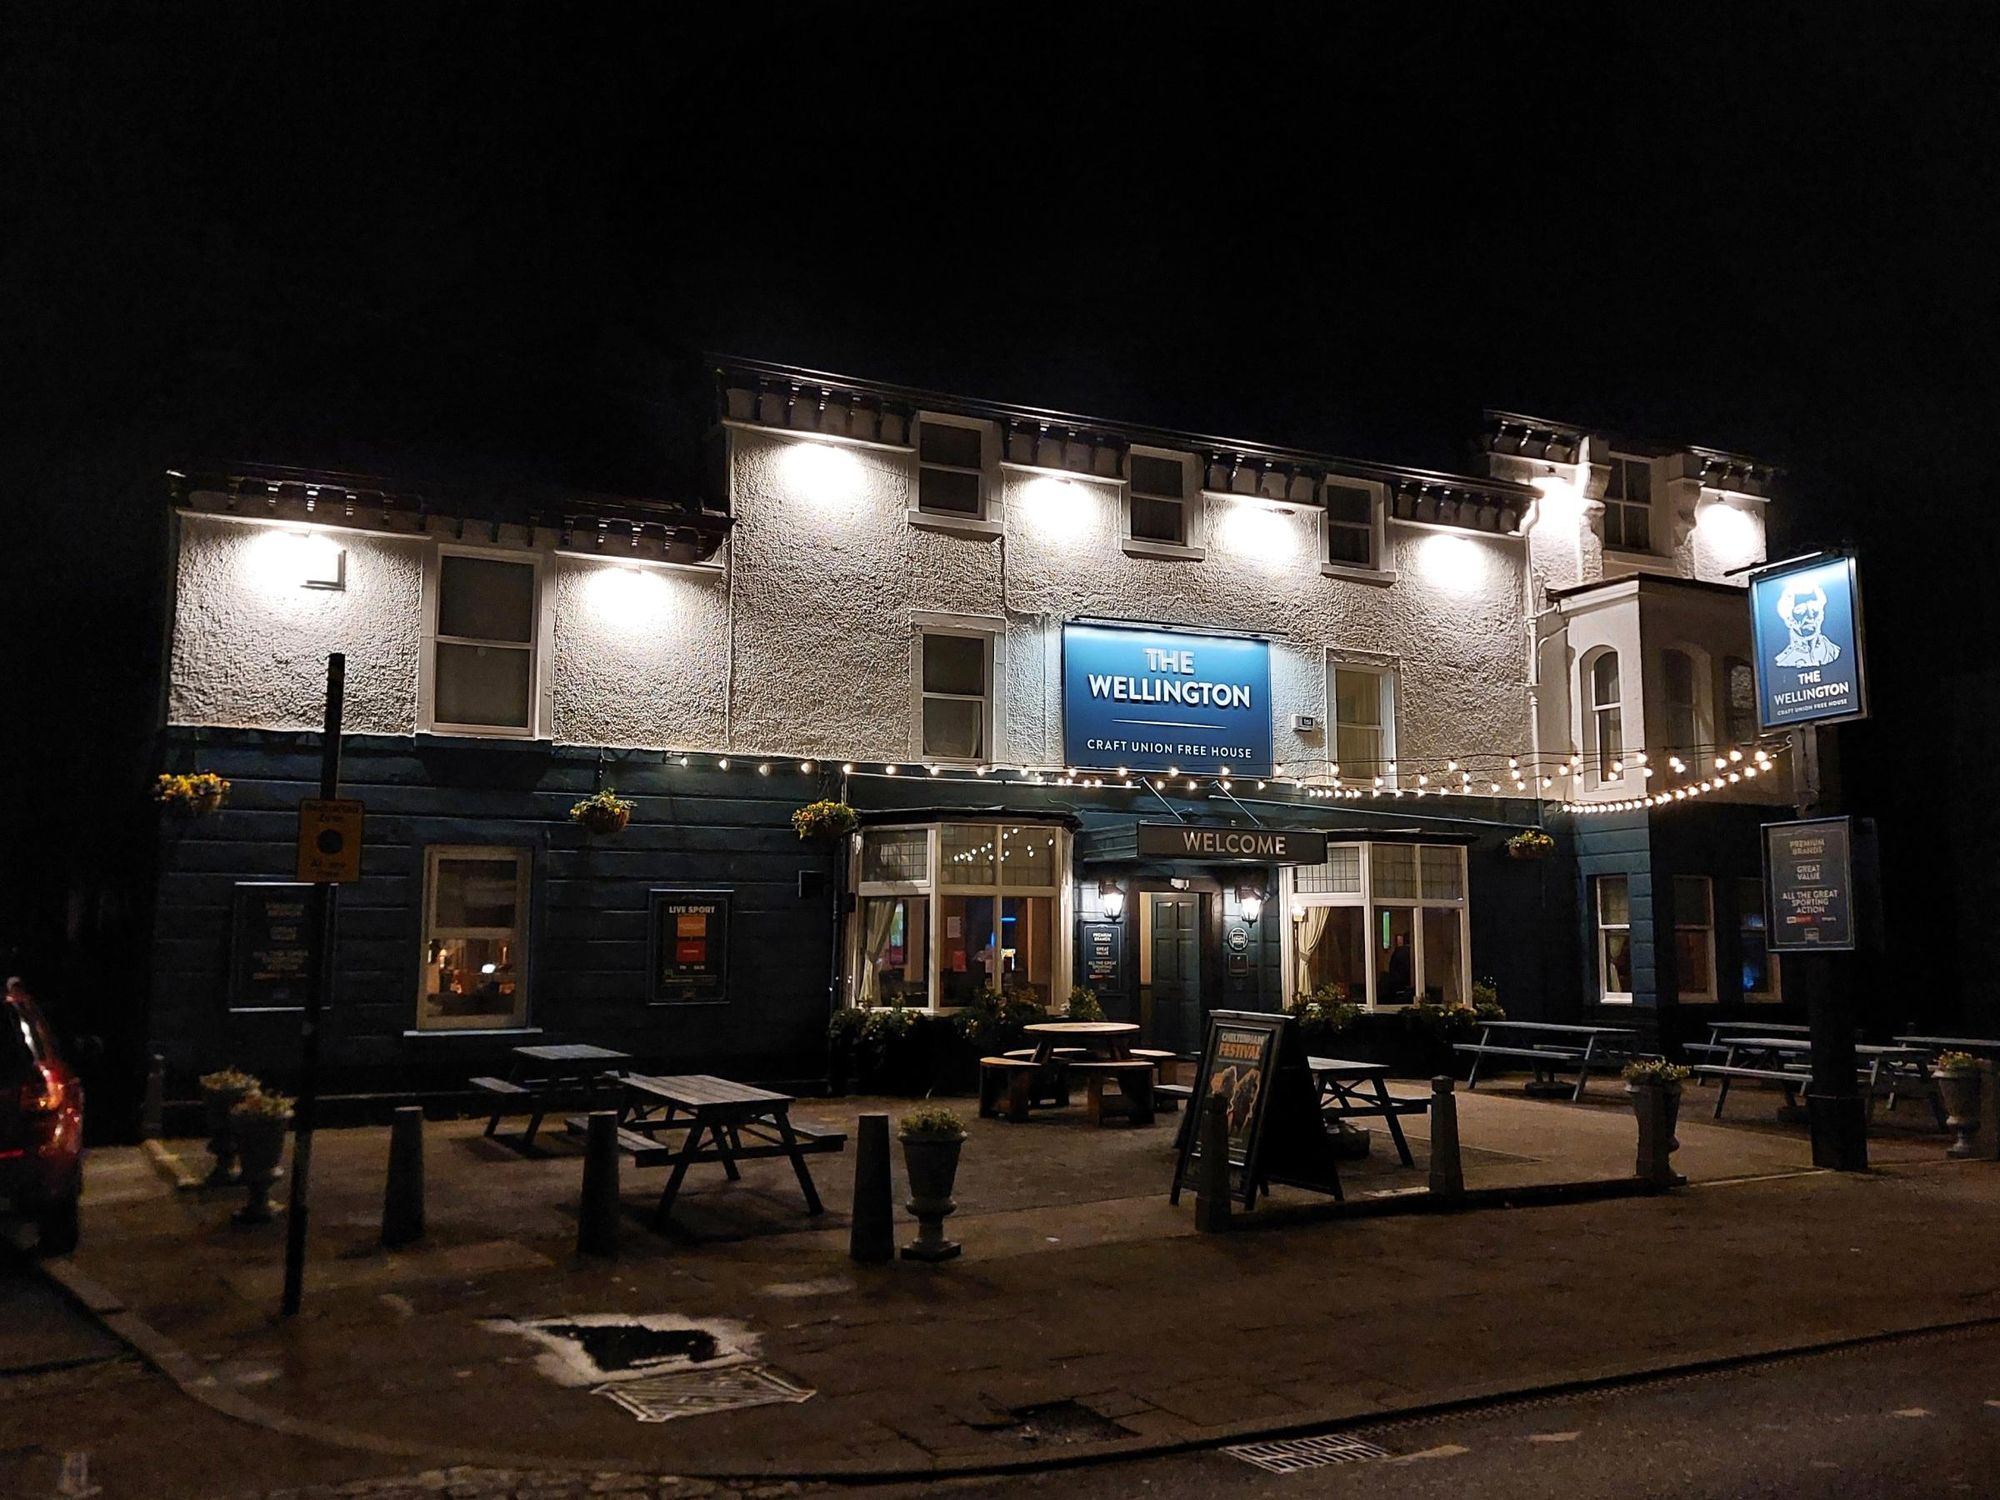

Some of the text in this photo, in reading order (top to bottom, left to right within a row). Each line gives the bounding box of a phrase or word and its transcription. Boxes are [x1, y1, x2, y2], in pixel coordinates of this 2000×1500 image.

[1144, 648, 1195, 674] THE
[1797, 670, 1821, 685] THE
[1088, 674, 1250, 708] WELLINGTON
[1774, 682, 1849, 706] WELLINGTON
[1777, 698, 1848, 716] CRAFT UNION FREE HOUSE
[1087, 738, 1252, 759] CRAFT UNION FREE HOUSE
[1183, 831, 1286, 855] WELCOME
[1790, 838, 1825, 848] PREMIUM
[1792, 846, 1823, 856] BRANDS
[1796, 864, 1821, 873] GREAT
[1797, 872, 1821, 880] VALUE
[1782, 889, 1838, 900] ALL THE GREAT
[1791, 898, 1829, 907] SPORTING
[669, 906, 715, 914] LIVE SPORT
[1796, 906, 1825, 914] ACTION
[1221, 1032, 1265, 1044] CHELTENHAM
[1219, 1042, 1261, 1059] FESTIVAL
